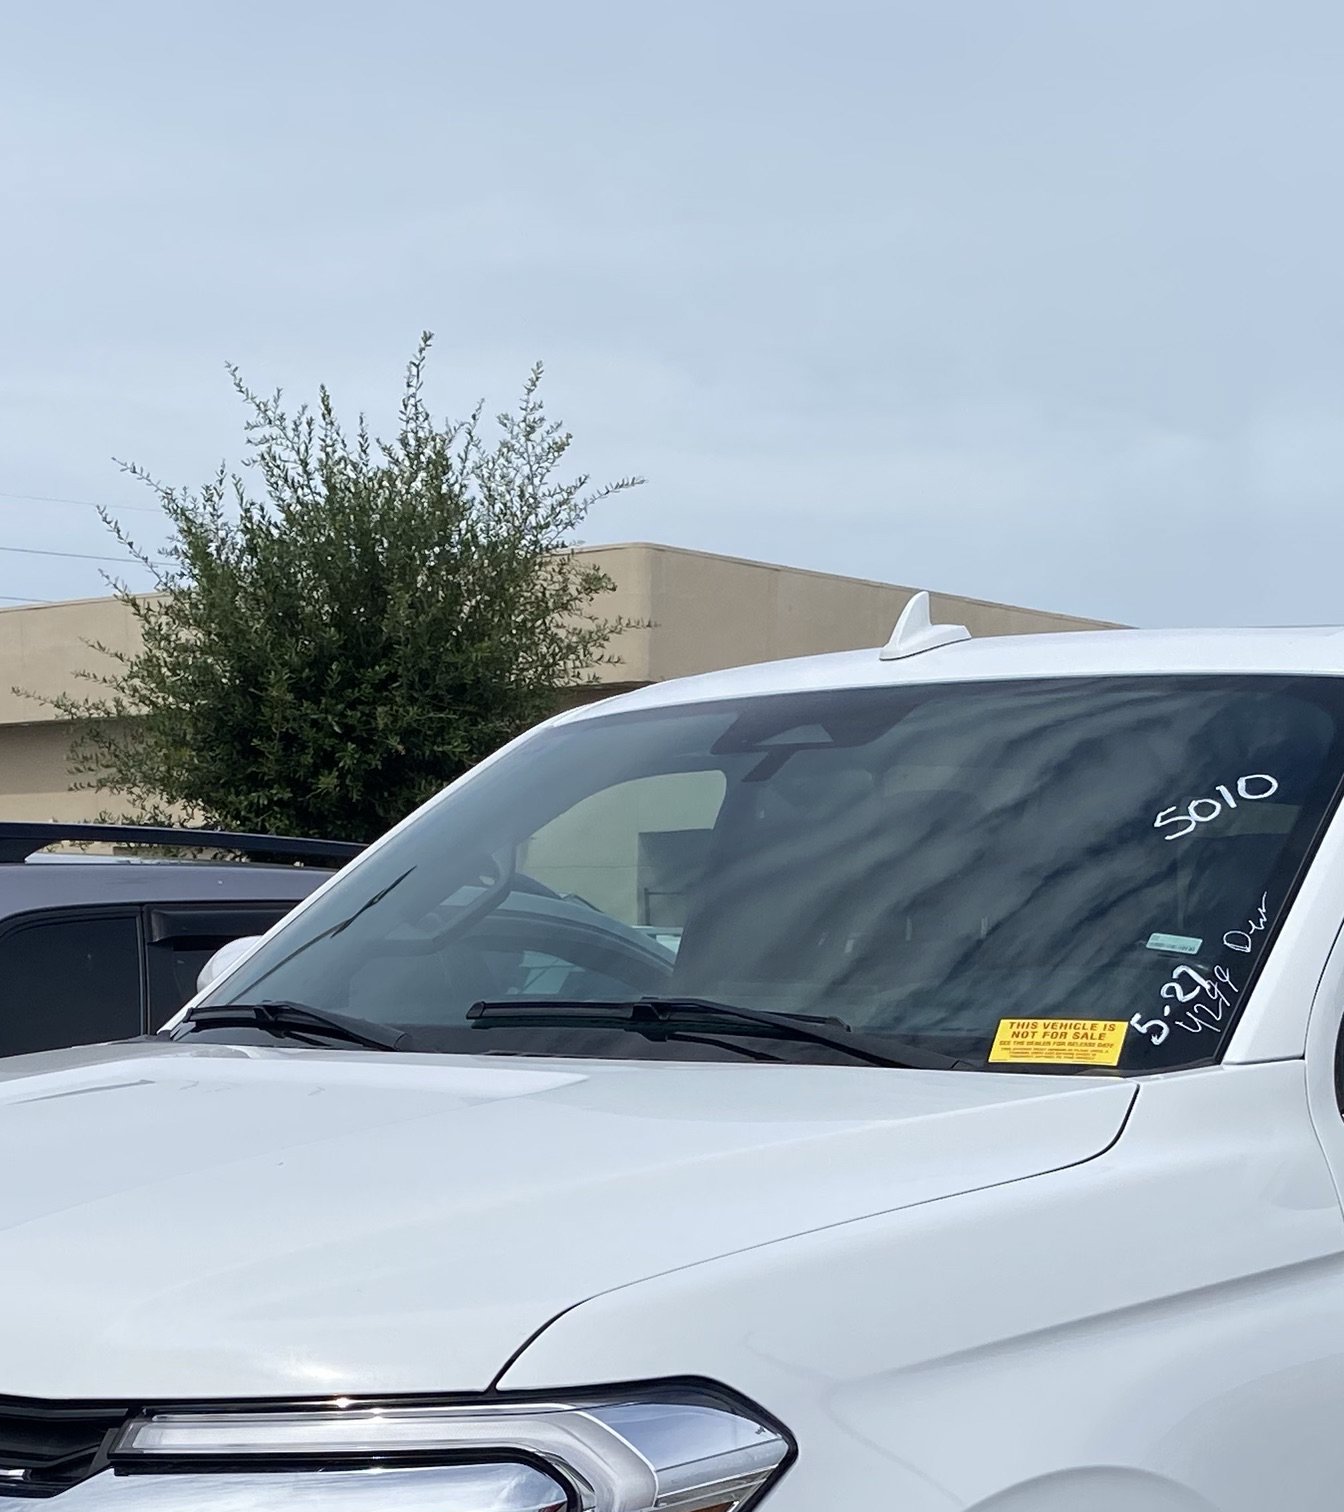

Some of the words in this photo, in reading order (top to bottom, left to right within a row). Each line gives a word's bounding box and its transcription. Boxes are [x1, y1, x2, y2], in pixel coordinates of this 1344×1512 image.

[1154, 774, 1278, 840] 5010
[1009, 1021, 1038, 1030] THIS
[1043, 1022, 1098, 1031] VEHICLE
[1103, 1023, 1116, 1032] IS
[1011, 1031, 1038, 1039] NOT
[1042, 1031, 1068, 1040] FOR
[1072, 1032, 1107, 1041] SALE
